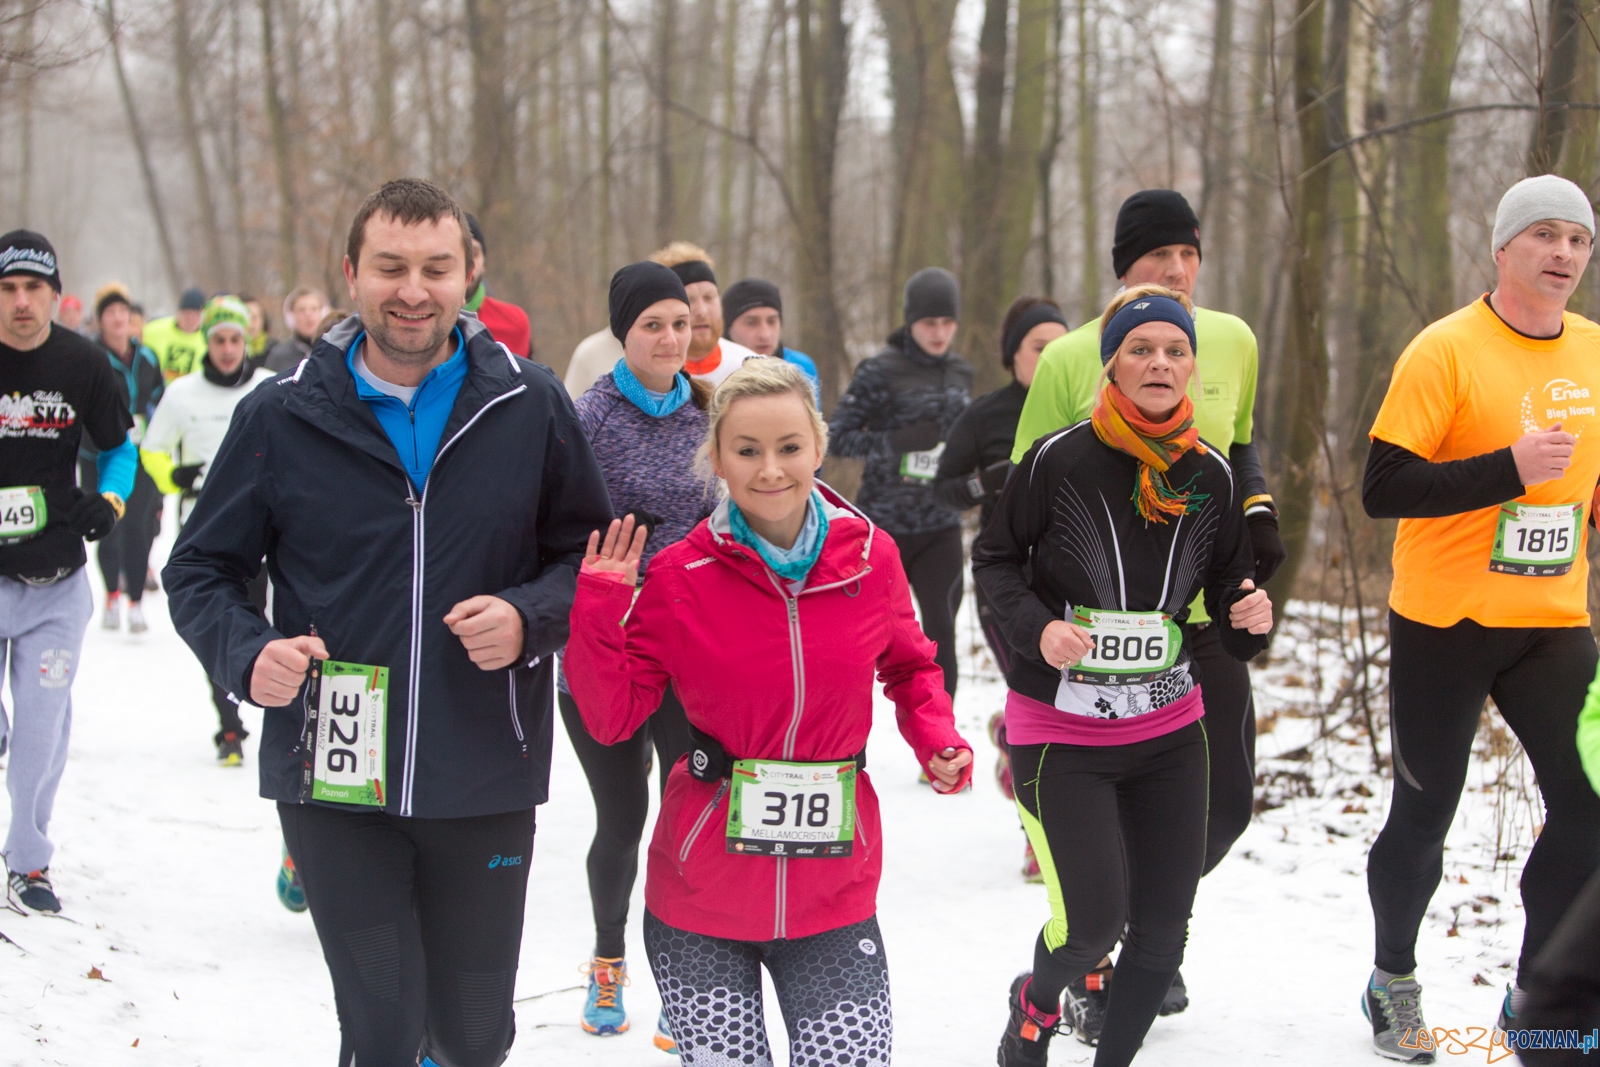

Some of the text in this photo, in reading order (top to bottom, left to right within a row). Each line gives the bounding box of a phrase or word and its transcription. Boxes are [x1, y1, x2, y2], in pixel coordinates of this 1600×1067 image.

[1551, 386, 1590, 401] Enea
[1546, 406, 1595, 420] Bieg Nocny
[0, 505, 35, 525] 49
[1517, 527, 1569, 553] 1815
[1090, 634, 1163, 661] 1806
[317, 711, 327, 751] TOMASZ
[327, 691, 360, 773] 326
[321, 787, 349, 798] Poznań
[762, 791, 829, 828] 318
[844, 799, 852, 831] Poznań
[751, 828, 835, 840] MELLAMOCRISTINA
[501, 855, 522, 867] asics
